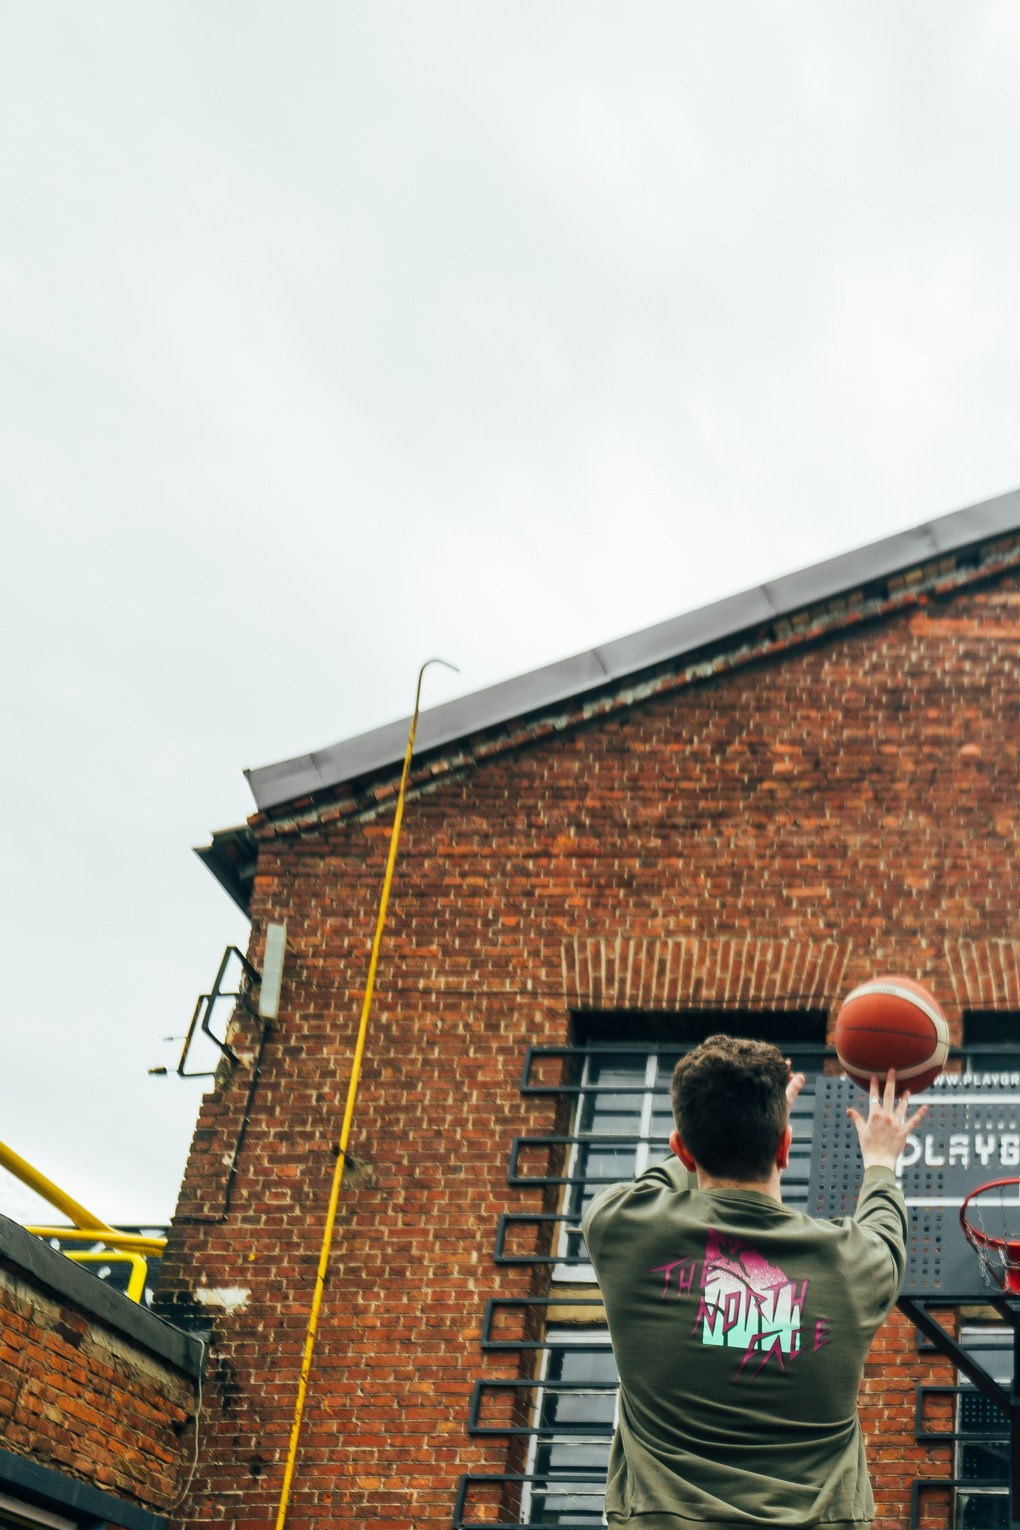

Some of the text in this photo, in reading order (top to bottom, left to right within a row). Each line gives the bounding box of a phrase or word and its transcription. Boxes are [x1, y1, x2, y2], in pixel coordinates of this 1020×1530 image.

[646, 1256, 723, 1299] THE
[691, 1279, 810, 1338] NORTH
[733, 1317, 833, 1384] FACE
